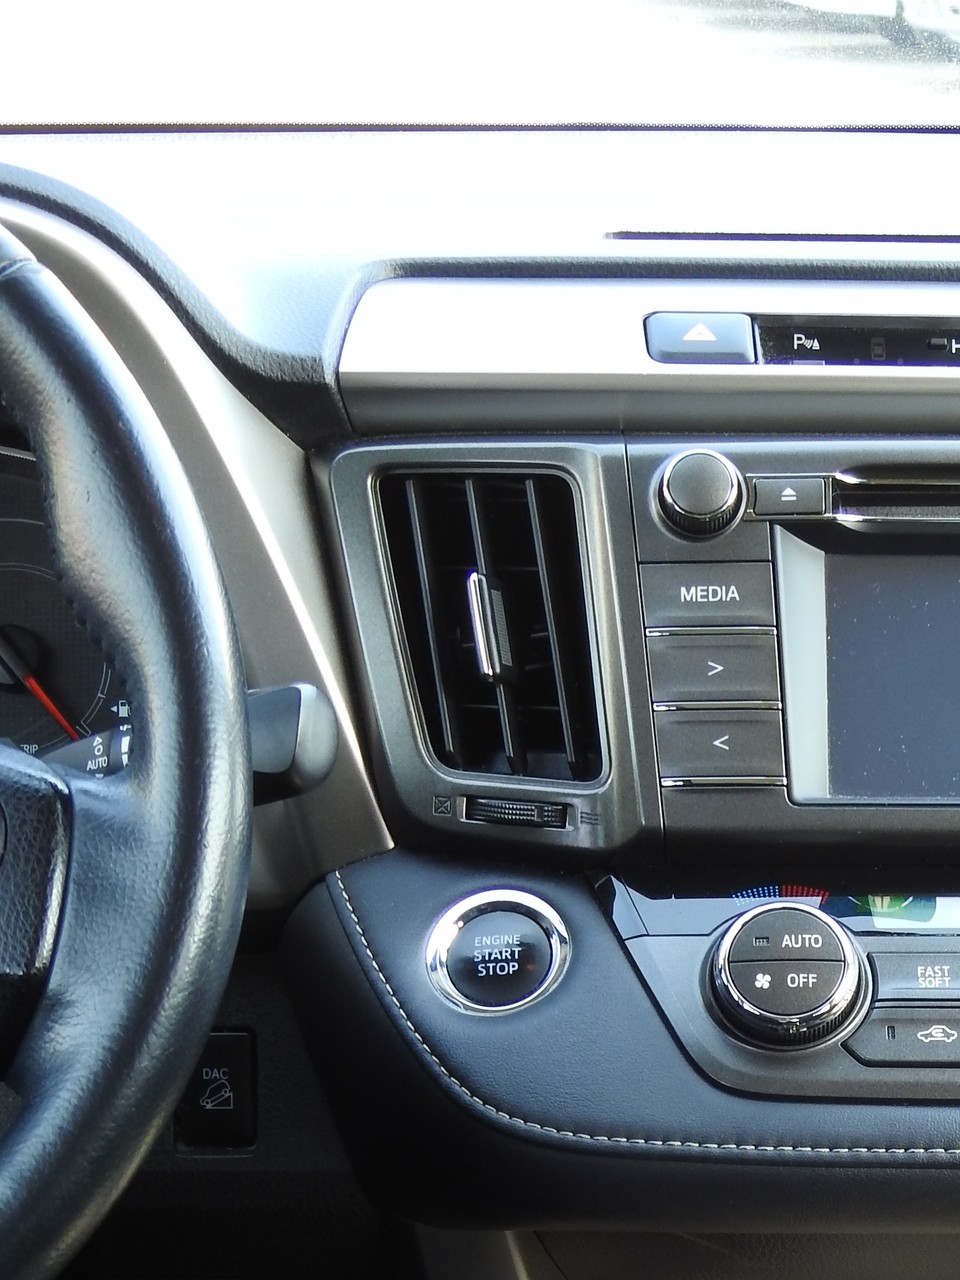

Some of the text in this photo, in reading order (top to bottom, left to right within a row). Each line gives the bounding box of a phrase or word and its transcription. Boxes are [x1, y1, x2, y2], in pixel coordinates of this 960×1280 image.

[680, 585, 740, 602] MEDIA
[86, 756, 108, 771] AUTO
[474, 934, 521, 947] ENGINE
[781, 934, 823, 948] AUTO
[473, 947, 522, 962] START
[477, 962, 519, 976] STOP
[917, 966, 951, 978] FAST
[787, 973, 818, 988] OFF
[918, 977, 952, 989] SOFT
[202, 1068, 229, 1080] DAC
